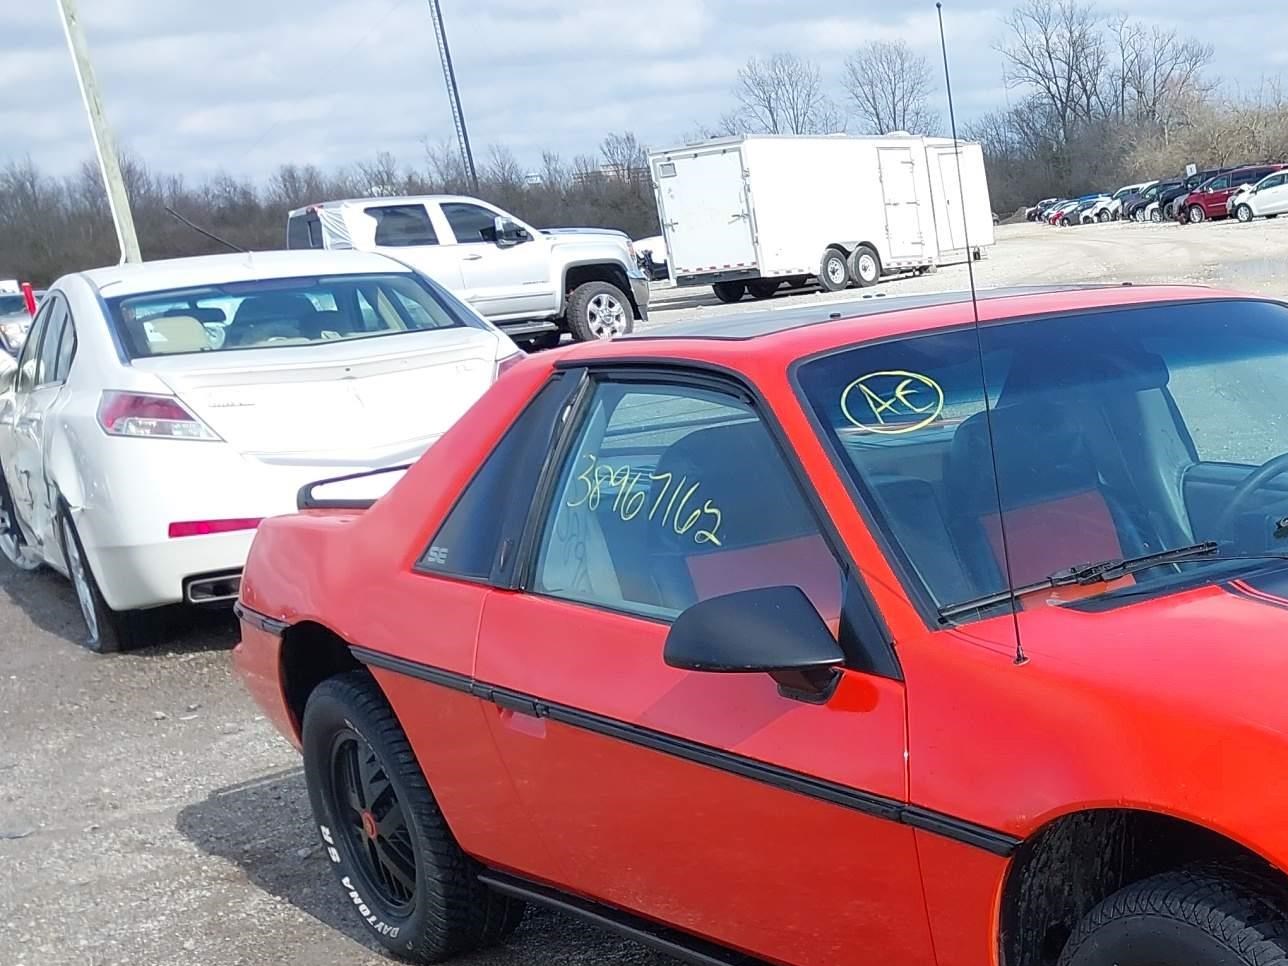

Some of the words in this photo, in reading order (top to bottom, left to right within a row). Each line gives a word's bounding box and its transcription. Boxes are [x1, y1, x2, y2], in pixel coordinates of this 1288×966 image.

[567, 454, 722, 546] 38967162
[320, 824, 341, 864] SR
[341, 876, 400, 938] DAYTONA
